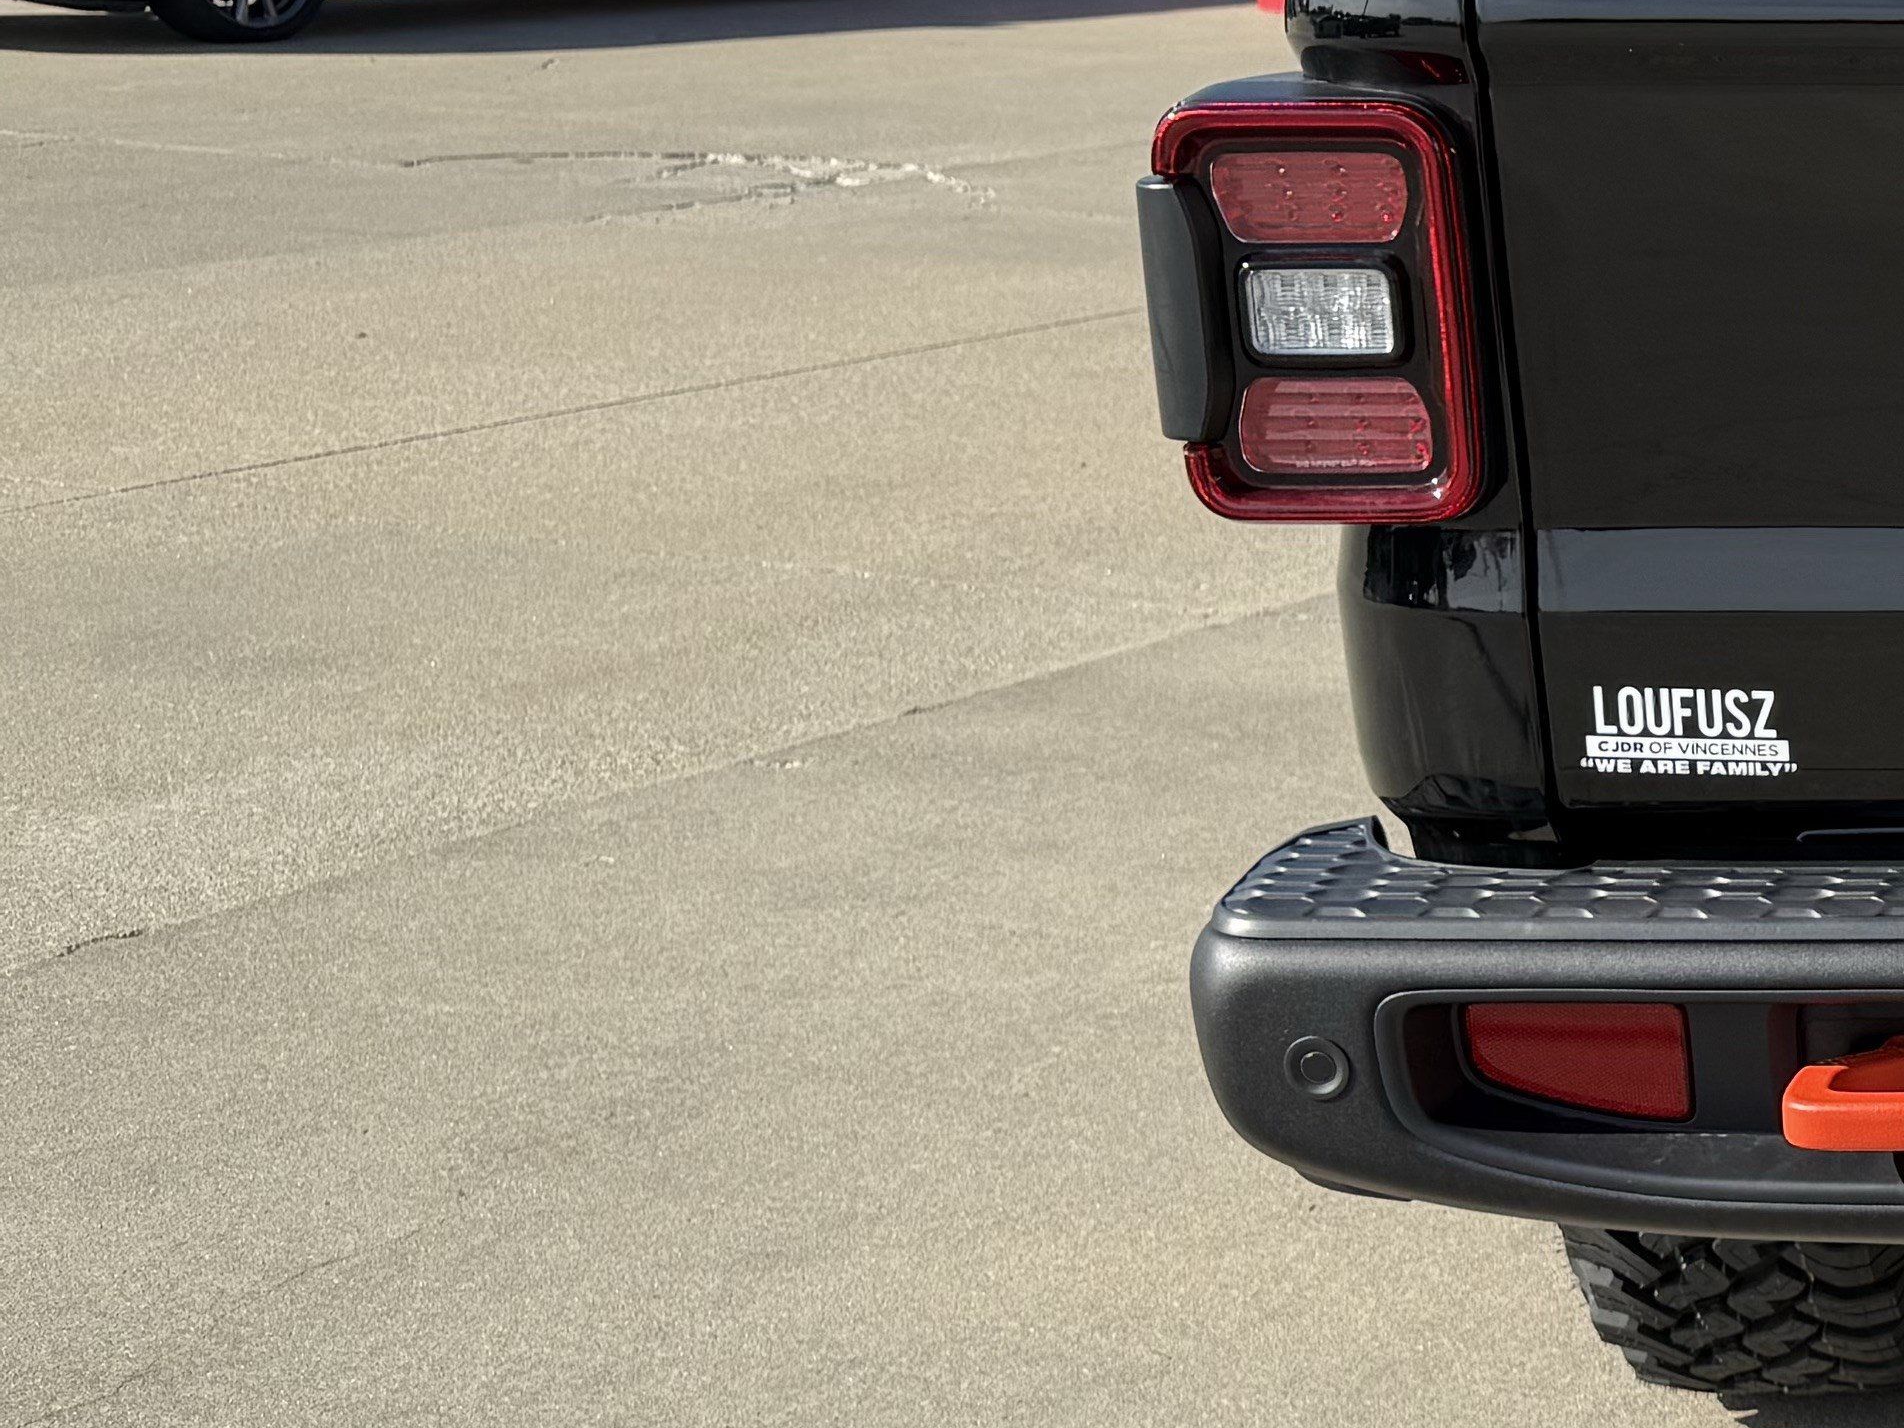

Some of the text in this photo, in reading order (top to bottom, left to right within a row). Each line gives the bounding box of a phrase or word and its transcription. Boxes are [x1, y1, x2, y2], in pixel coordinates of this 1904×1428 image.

[1597, 740, 1779, 756] CJDR OF VINCENNES
[1639, 759, 1690, 774] ARE
